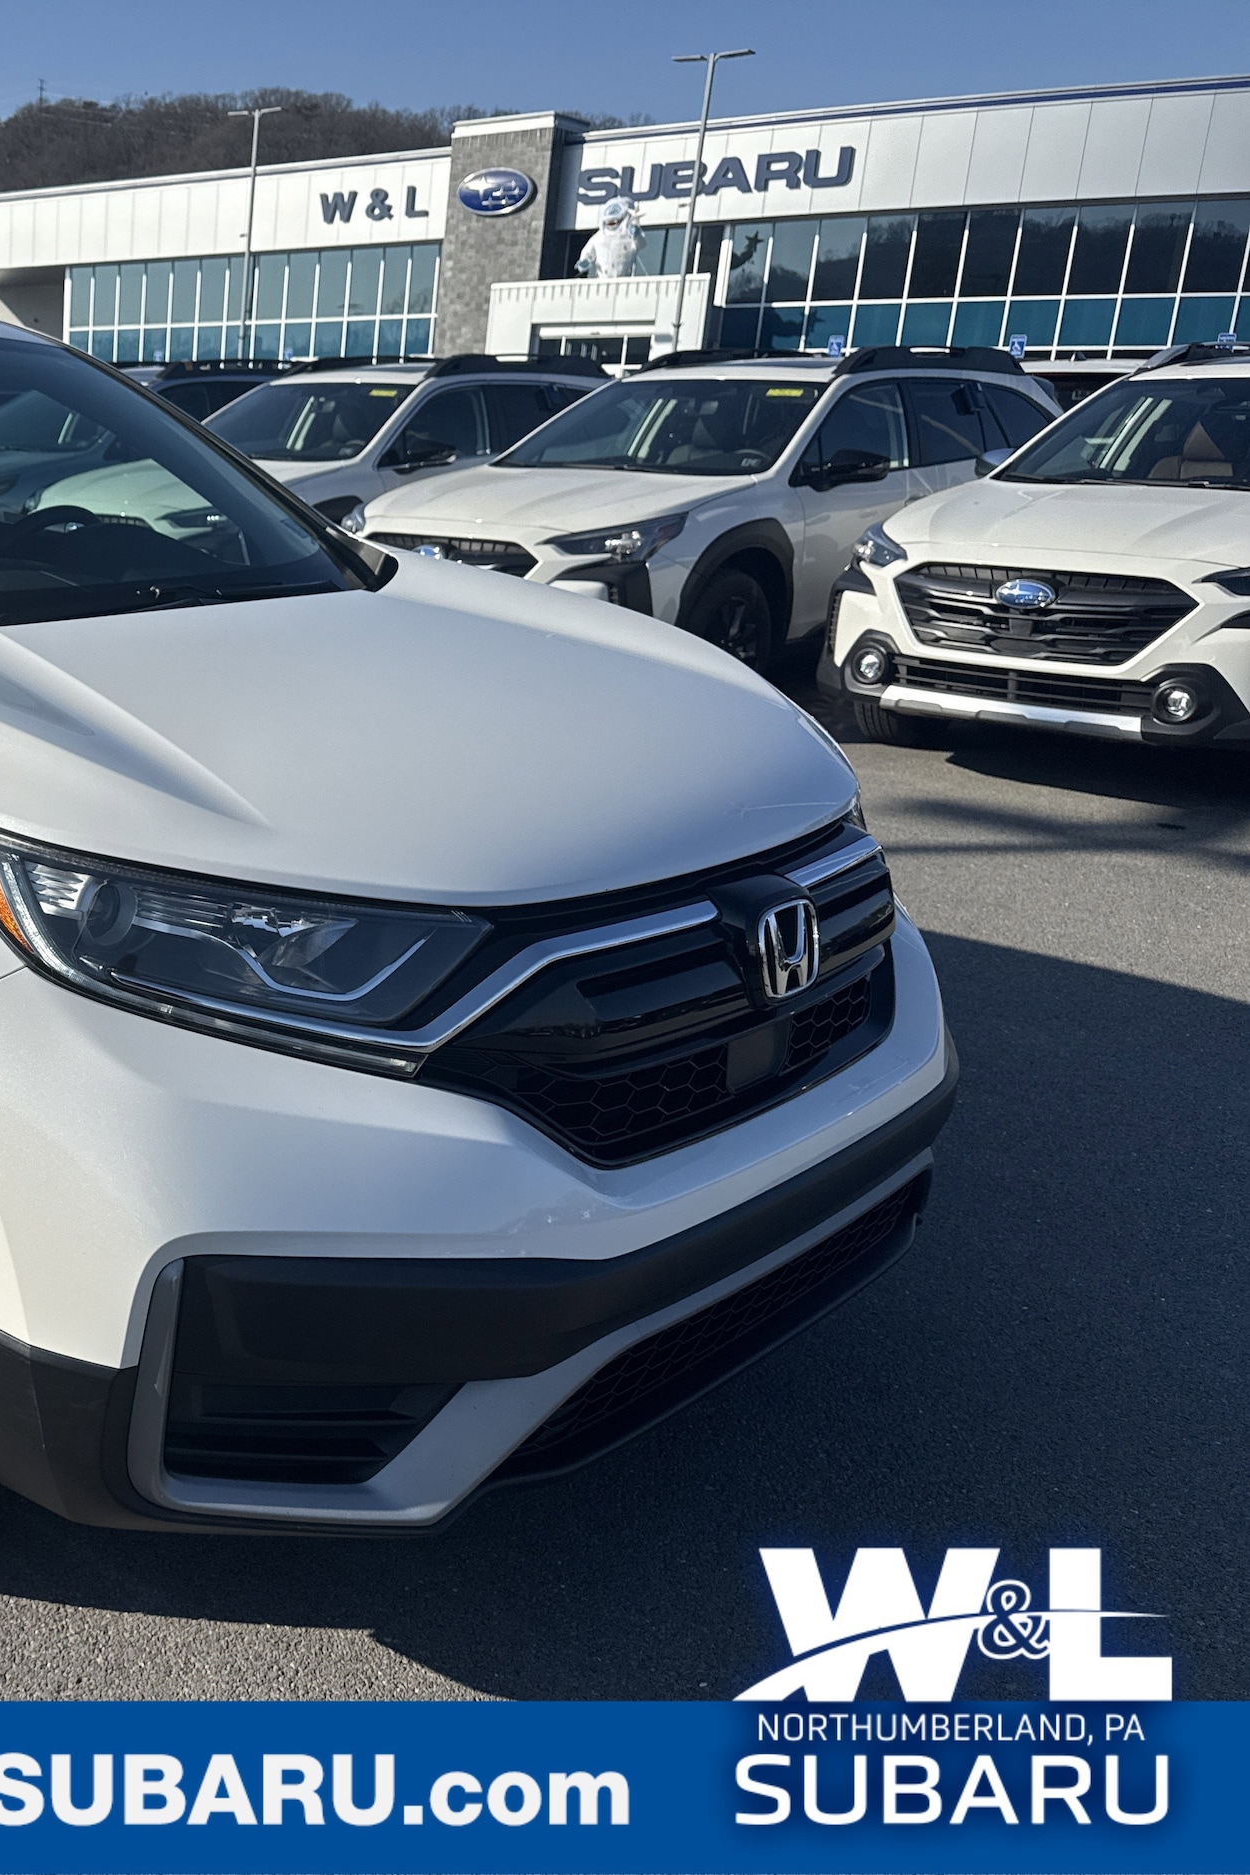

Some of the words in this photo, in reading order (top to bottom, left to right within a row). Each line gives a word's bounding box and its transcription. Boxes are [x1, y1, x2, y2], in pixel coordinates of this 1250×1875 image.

[576, 146, 856, 206] SUBARU
[319, 190, 358, 224] W
[365, 188, 394, 221] &
[405, 185, 429, 218] L
